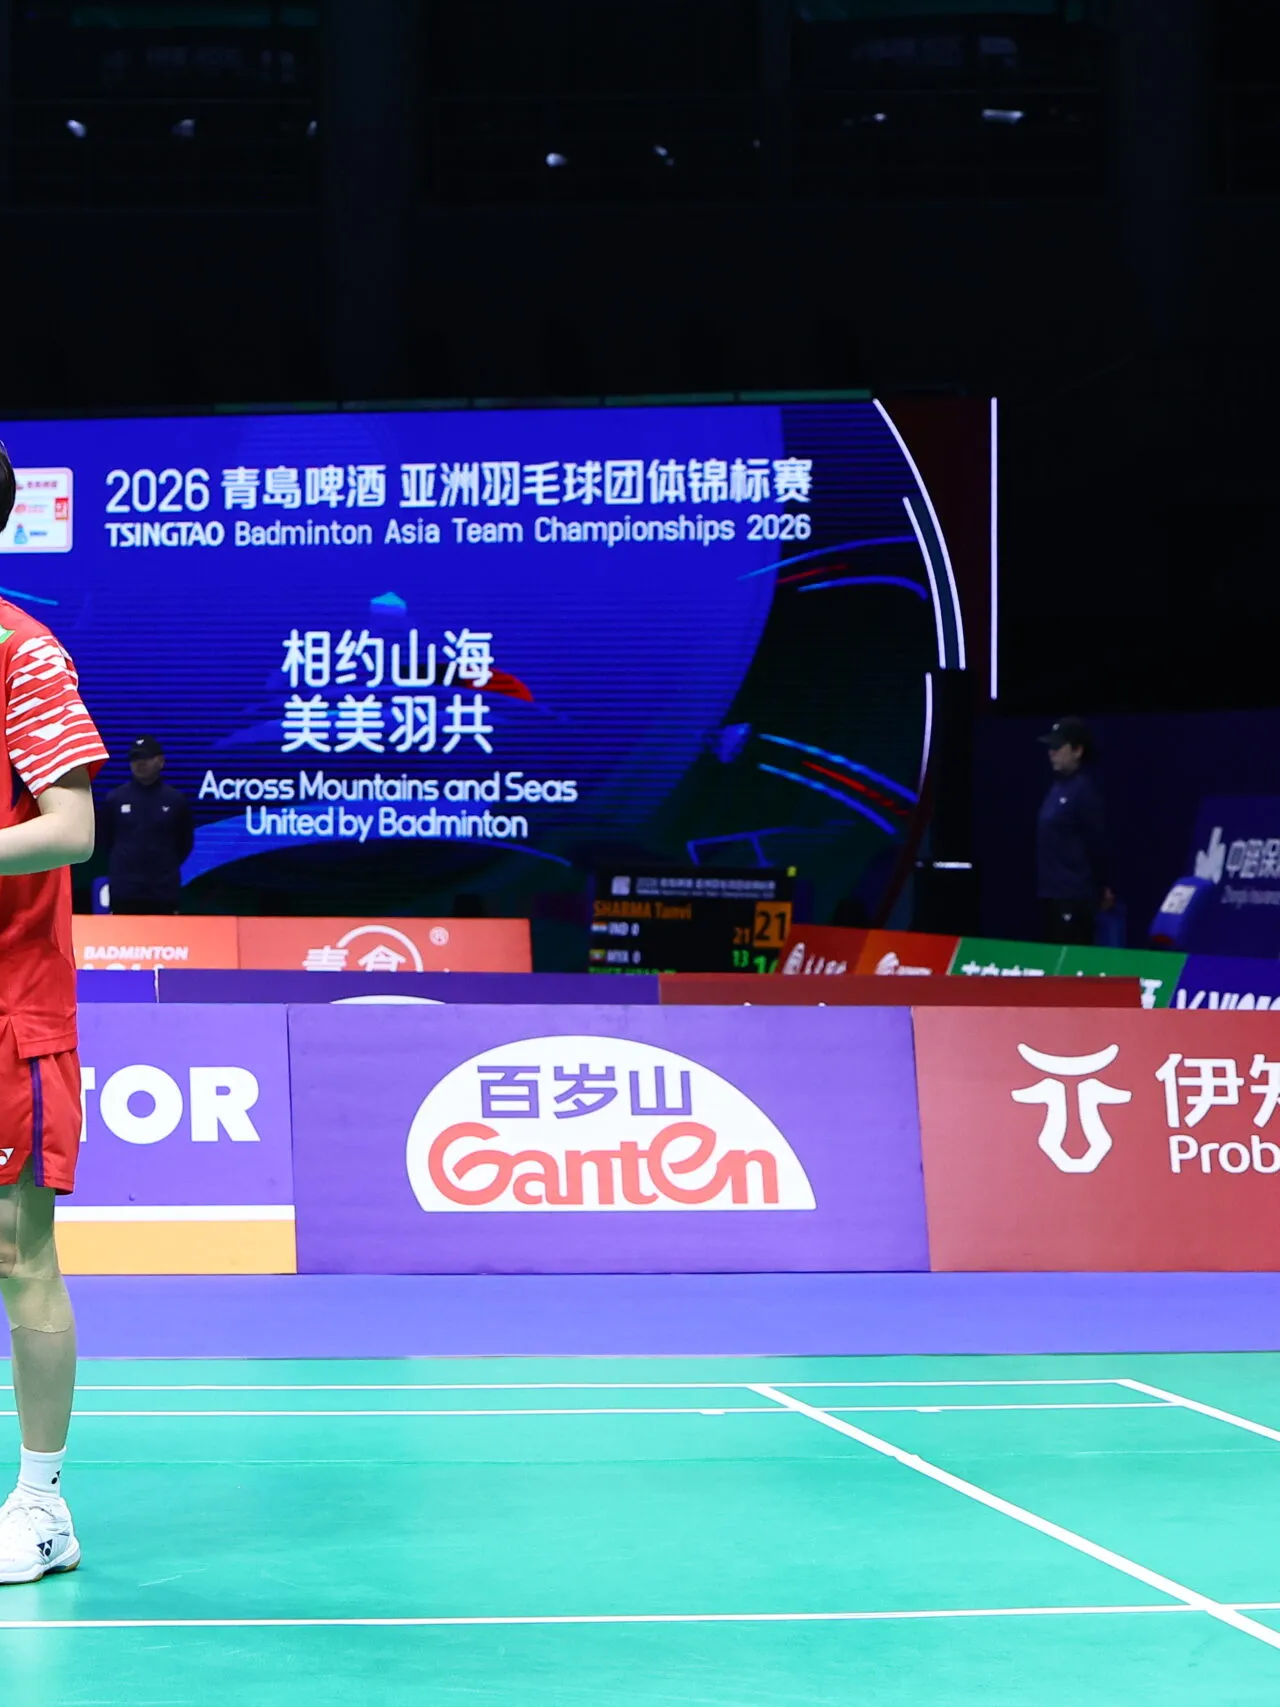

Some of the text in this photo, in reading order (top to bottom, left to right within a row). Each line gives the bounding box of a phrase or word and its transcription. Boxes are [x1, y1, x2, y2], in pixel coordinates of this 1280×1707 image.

[105, 468, 210, 513] 2026
[400, 457, 813, 509] 亚洲羽毛球团体锦标赛
[104, 513, 812, 548] TSINGTAO Badminton Asia Team Championships 2026
[280, 627, 495, 689] 相约山海
[280, 693, 494, 754] 美美羽共
[198, 769, 579, 803] Across Mountains and Seas
[245, 804, 529, 843] United by Badminton
[756, 910, 787, 942] 21
[83, 945, 189, 961] BADMINTON
[476, 1062, 692, 1120] 百岁山
